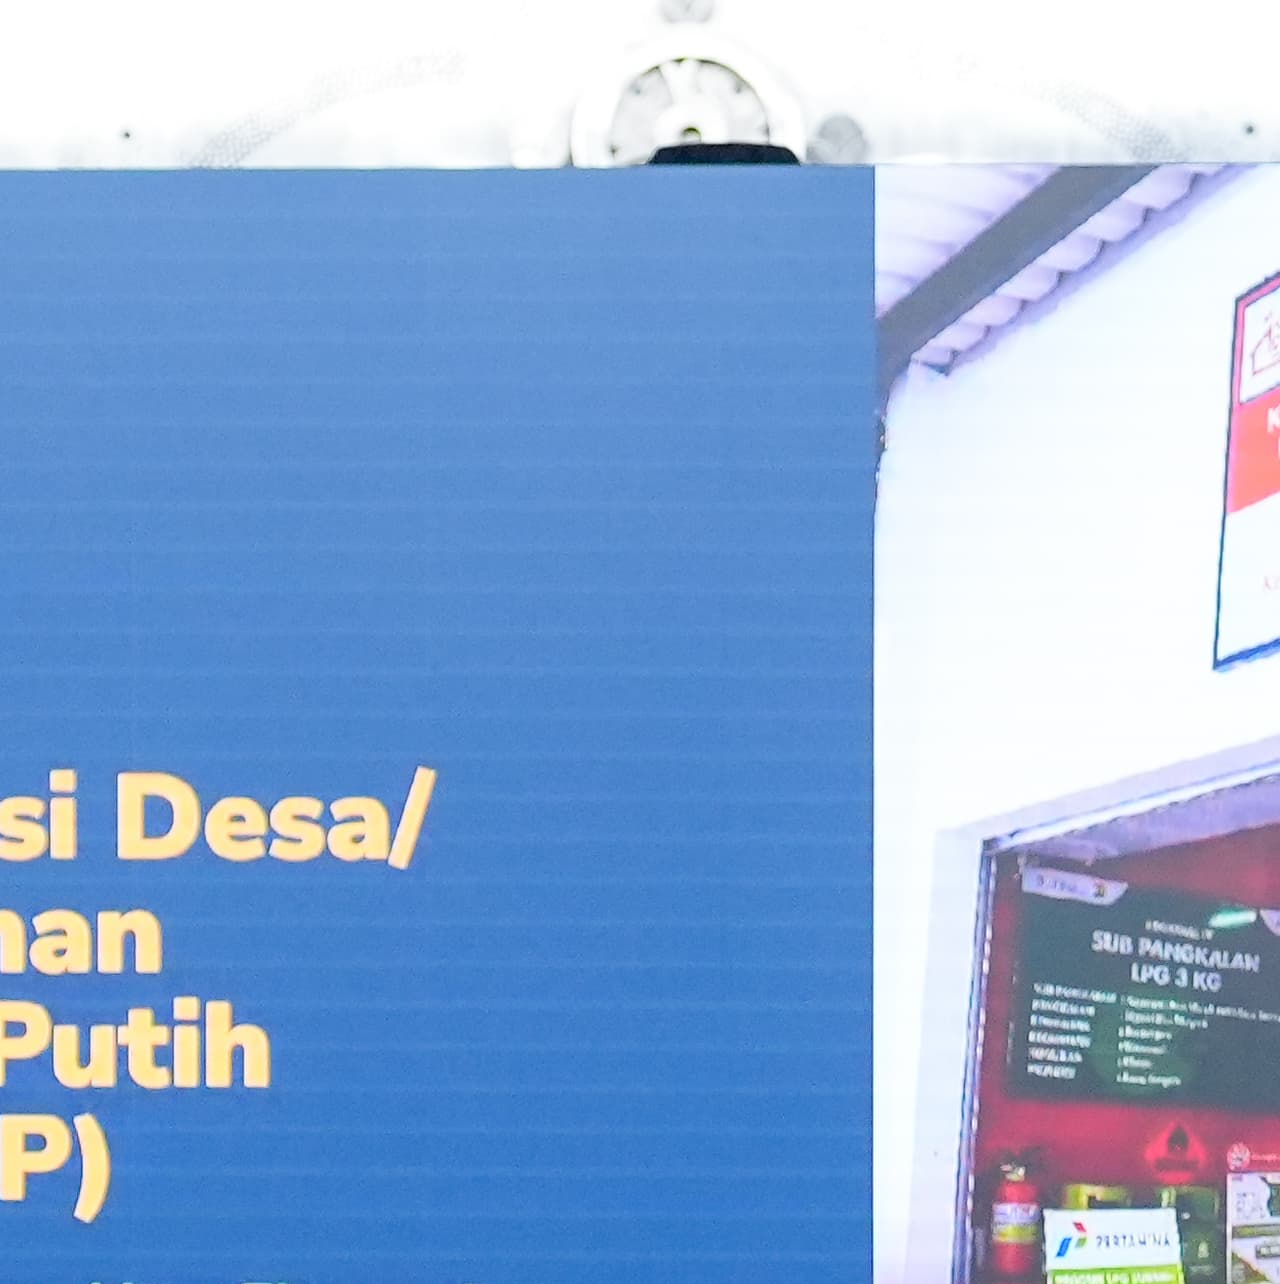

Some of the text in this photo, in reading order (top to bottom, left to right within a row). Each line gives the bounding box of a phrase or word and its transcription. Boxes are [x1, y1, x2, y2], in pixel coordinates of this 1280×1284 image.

[118, 766, 437, 869] Desa/
[1091, 929, 1134, 955] SUB
[1131, 962, 1222, 993] LPG 3 KG
